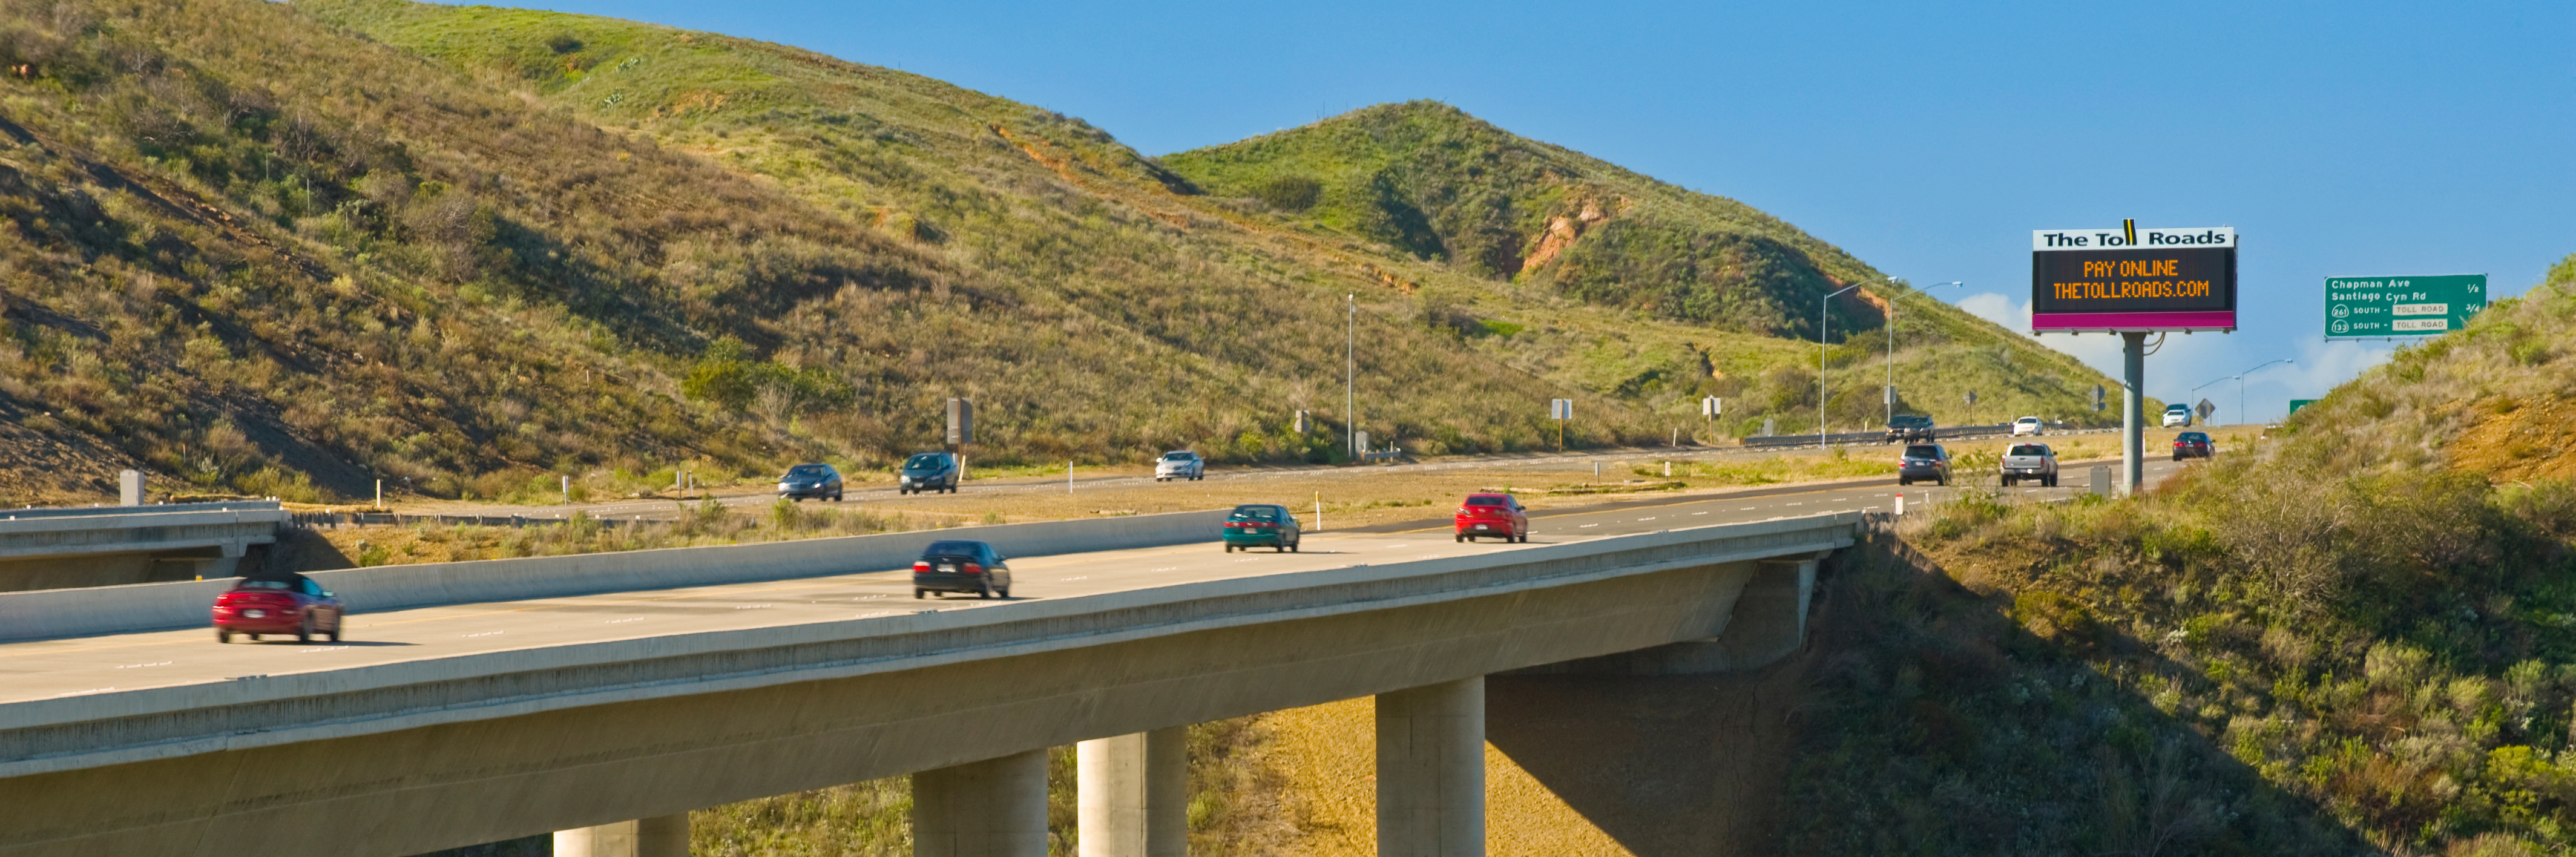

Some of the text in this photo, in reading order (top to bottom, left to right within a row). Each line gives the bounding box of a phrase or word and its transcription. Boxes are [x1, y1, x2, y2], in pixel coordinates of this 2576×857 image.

[2044, 218, 2226, 246] The Toll Roads
[2084, 260, 2178, 277] PAY ONLINE
[2054, 280, 2209, 299] THETOLLROADS.COM
[2331, 279, 2410, 290] Chapman Ave
[2468, 284, 2479, 293] 1/2
[2331, 292, 2426, 304] Santiago Cyn Rd
